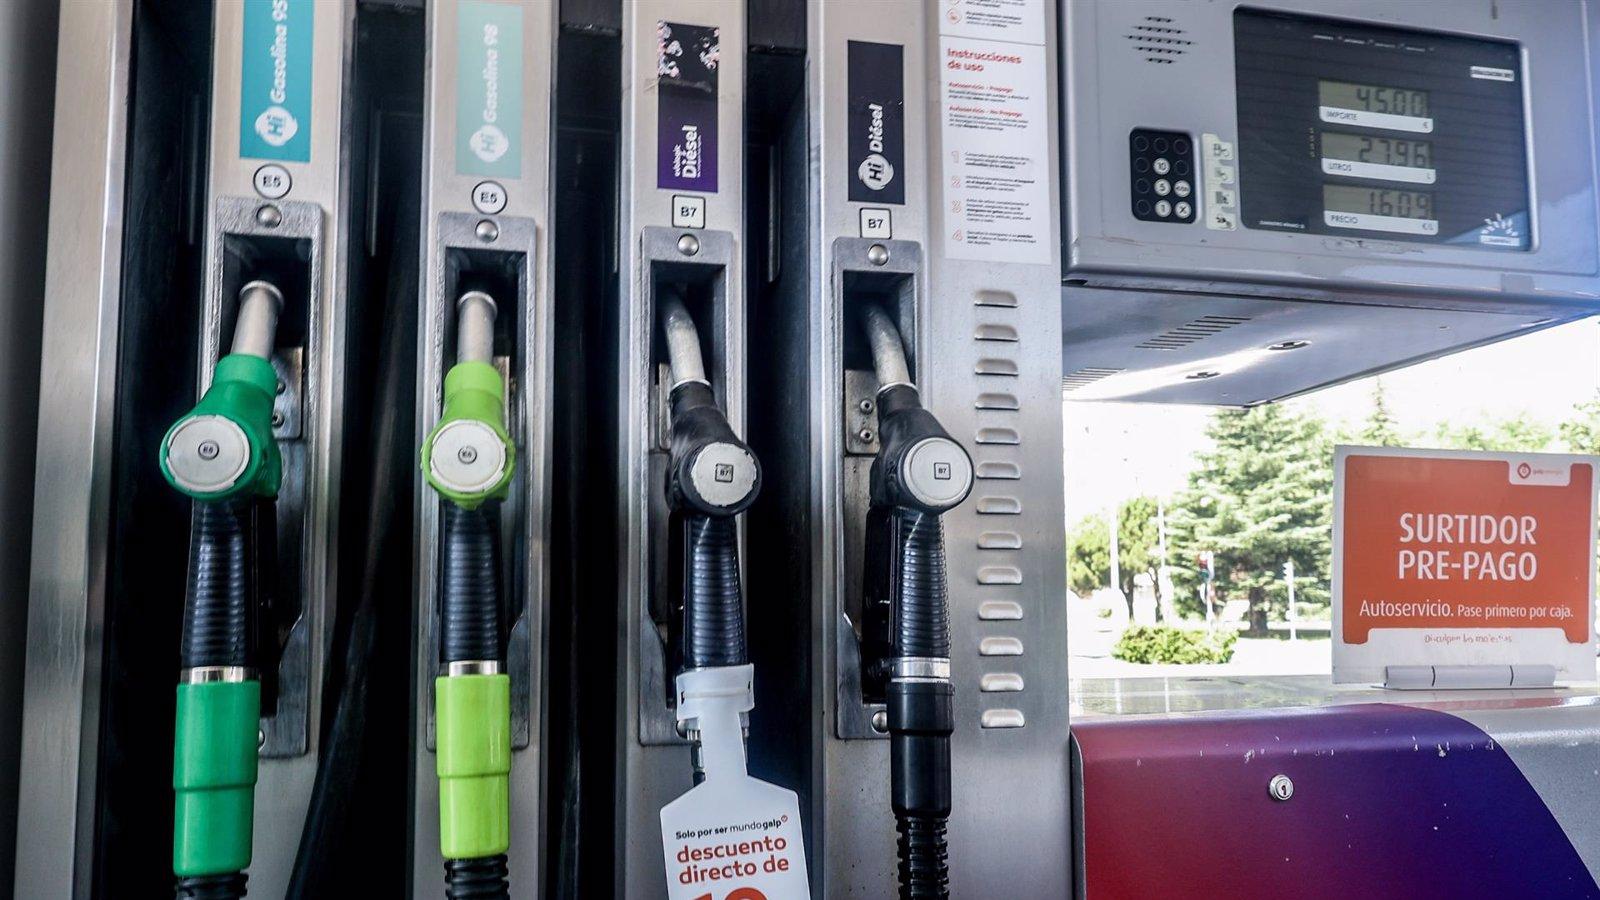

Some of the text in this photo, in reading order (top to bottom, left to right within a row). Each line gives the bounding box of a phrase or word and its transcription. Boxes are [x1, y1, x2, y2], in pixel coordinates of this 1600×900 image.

[271, 0, 288, 21] 95
[270, 23, 287, 104] Gasolina
[947, 48, 1022, 64] Instrucciones
[947, 60, 984, 72] de uso
[482, 49, 498, 123] Gasolina
[1327, 111, 1358, 120] IMPORTE
[867, 162, 882, 181] Hi
[1328, 162, 1352, 172] LITROS
[262, 176, 281, 188] E5
[480, 192, 498, 203] E5
[680, 206, 697, 217] B7
[1330, 215, 1358, 224] PRECIO
[868, 218, 884, 229] B7
[1399, 512, 1537, 545] SURTIDOR
[1398, 549, 1537, 581] PRE-PAGO
[1359, 600, 1574, 620] Autoservicio. Pase primero por caja.
[675, 829, 696, 840] Solo
[697, 828, 712, 839] por
[714, 826, 728, 835] ser
[676, 835, 787, 863] descuento
[678, 855, 789, 885] directo de
